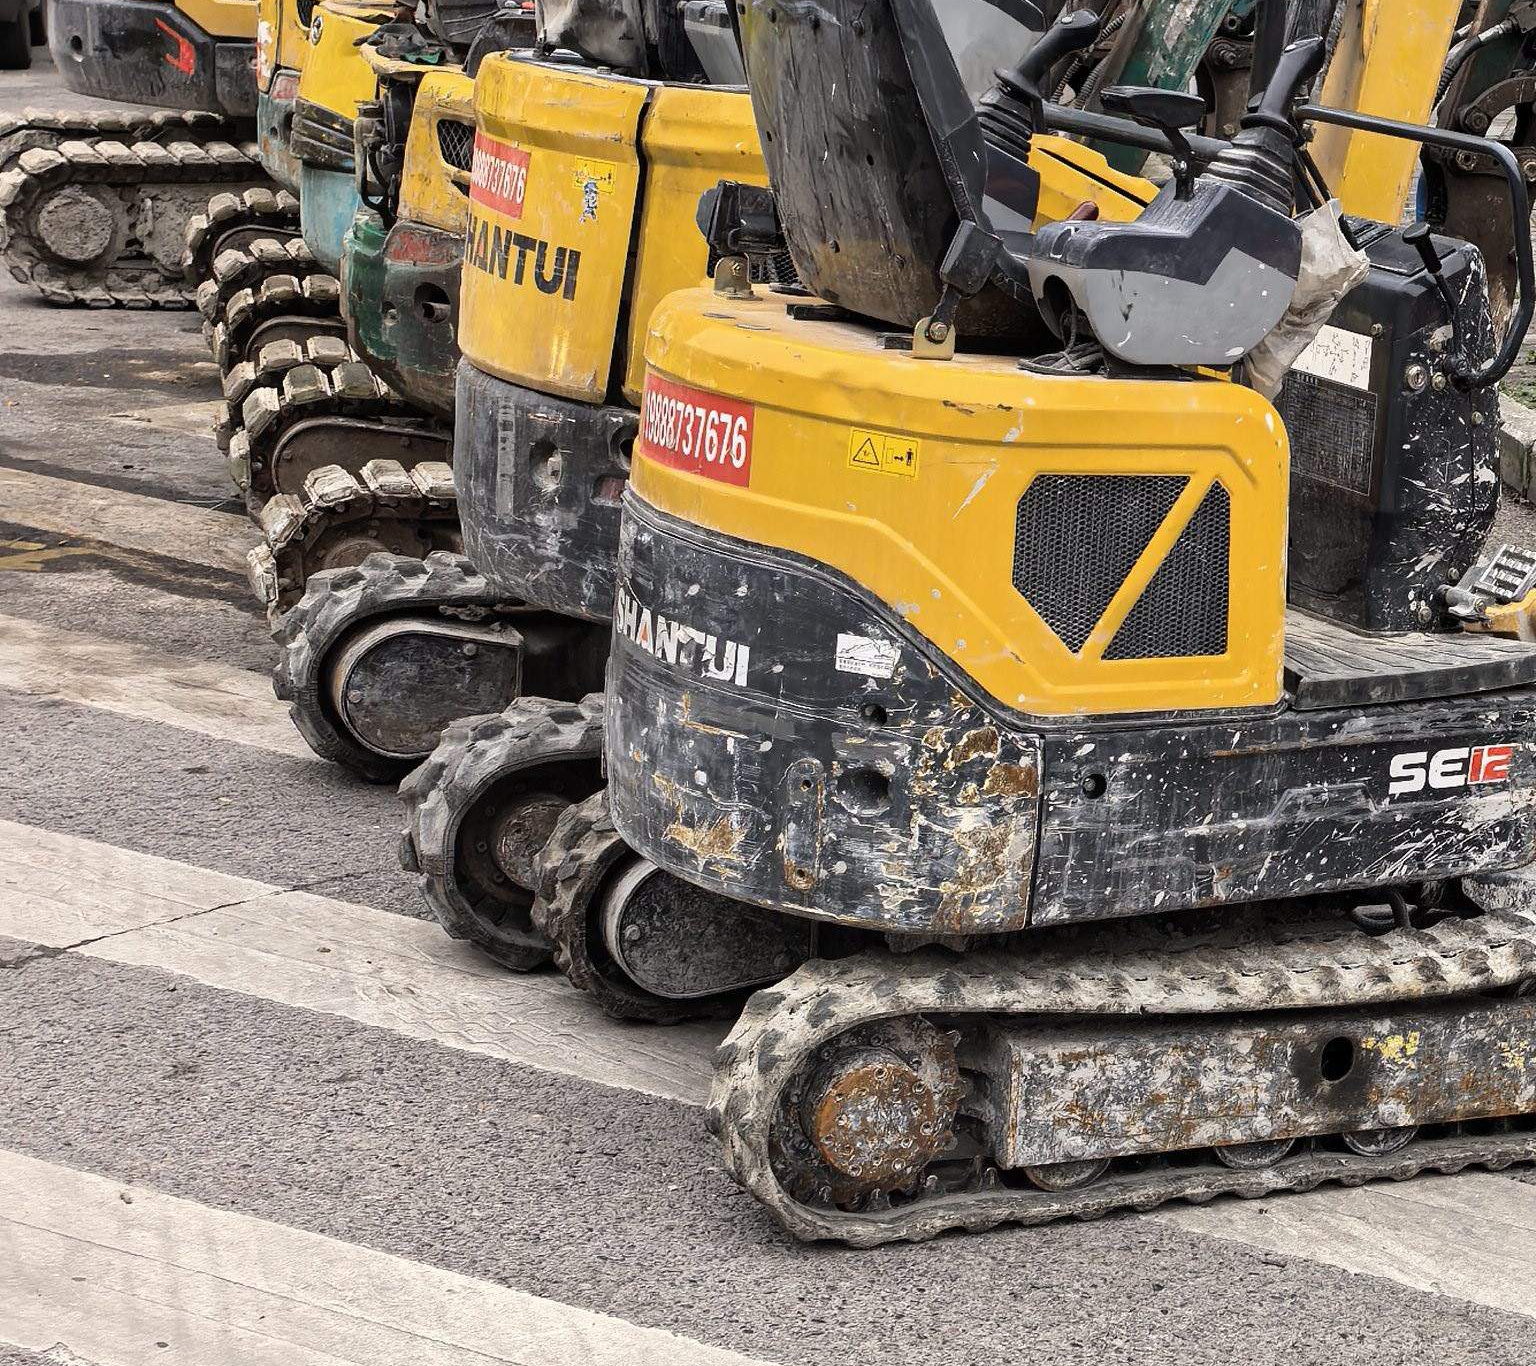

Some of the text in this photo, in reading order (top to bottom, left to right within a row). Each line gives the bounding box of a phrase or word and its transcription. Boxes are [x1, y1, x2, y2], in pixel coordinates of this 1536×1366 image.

[466, 212, 581, 302] HANTUI
[645, 390, 748, 469] 19888737676
[616, 587, 750, 686] SHANTUI
[1388, 744, 1515, 795] SE12
